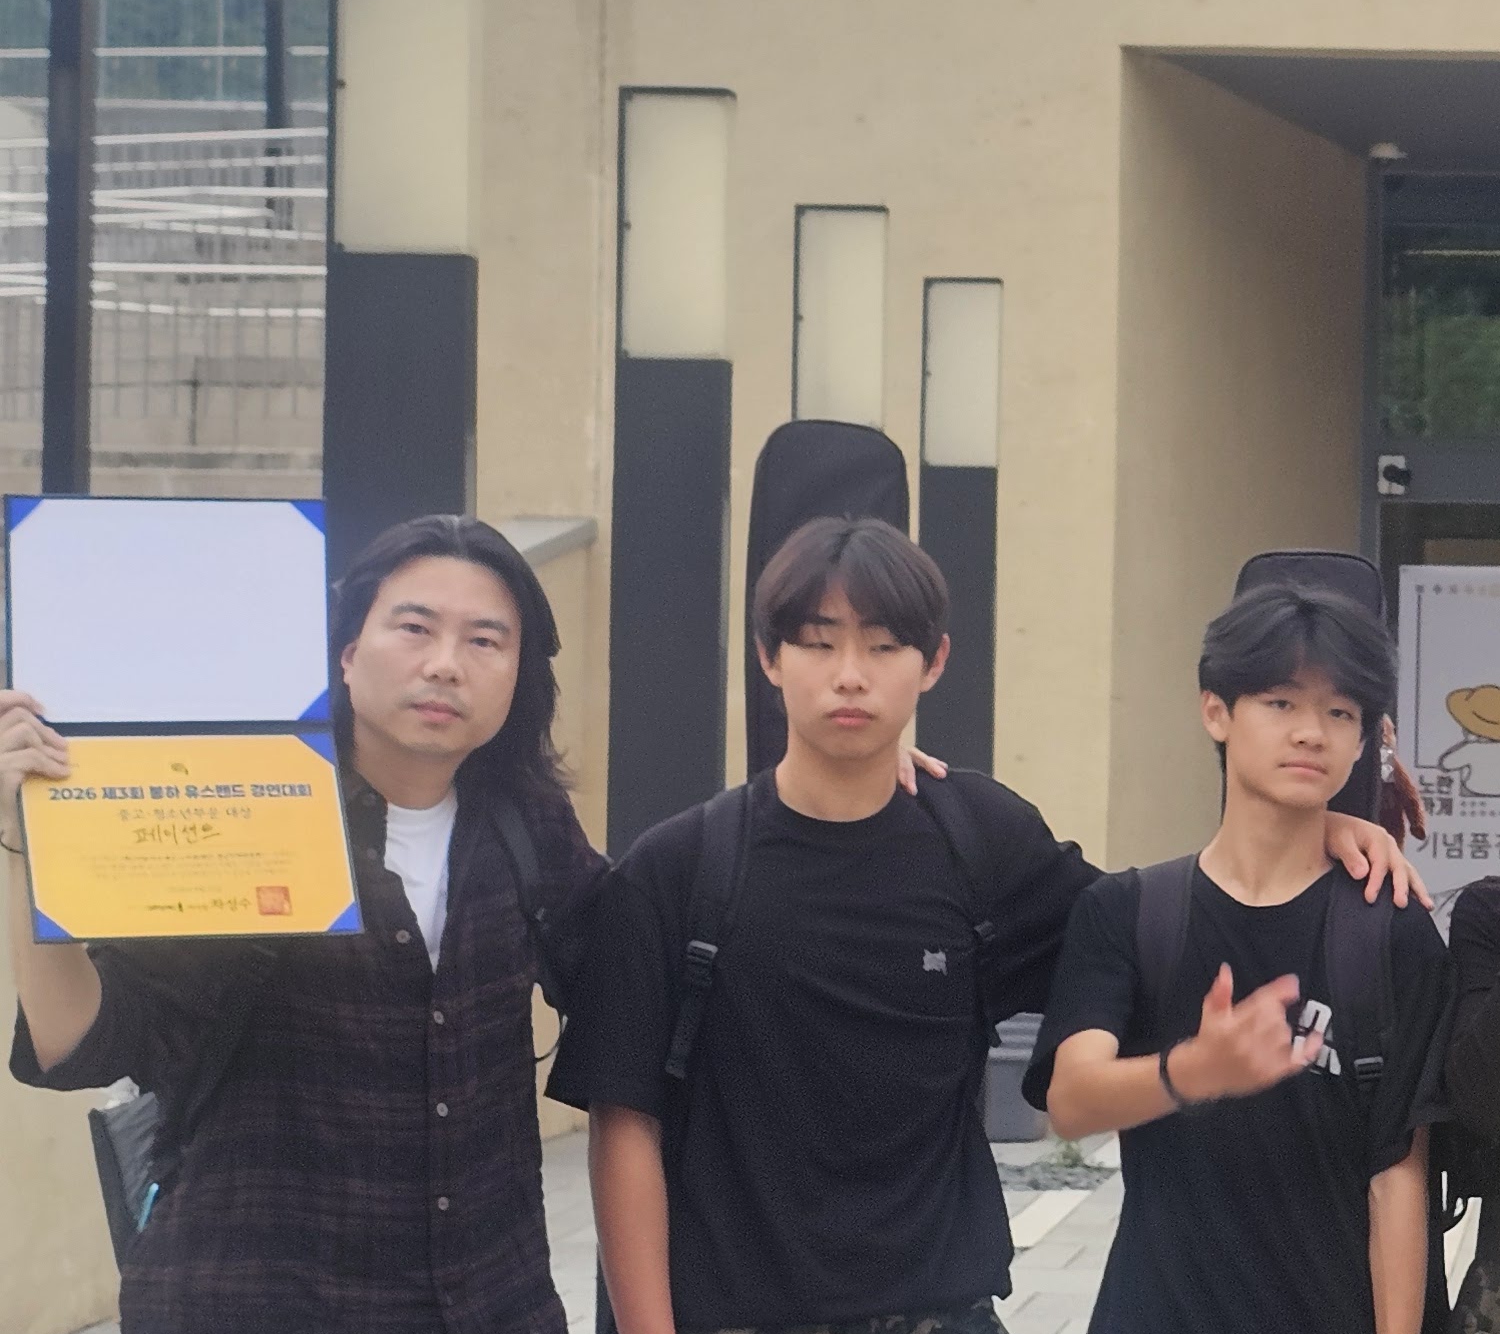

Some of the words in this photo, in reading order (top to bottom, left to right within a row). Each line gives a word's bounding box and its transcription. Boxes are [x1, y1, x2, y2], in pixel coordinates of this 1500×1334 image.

[49, 787, 97, 801] 2026
[102, 785, 145, 800] 제3회
[185, 784, 247, 799] 유스밴드
[251, 783, 313, 798] 경연대회
